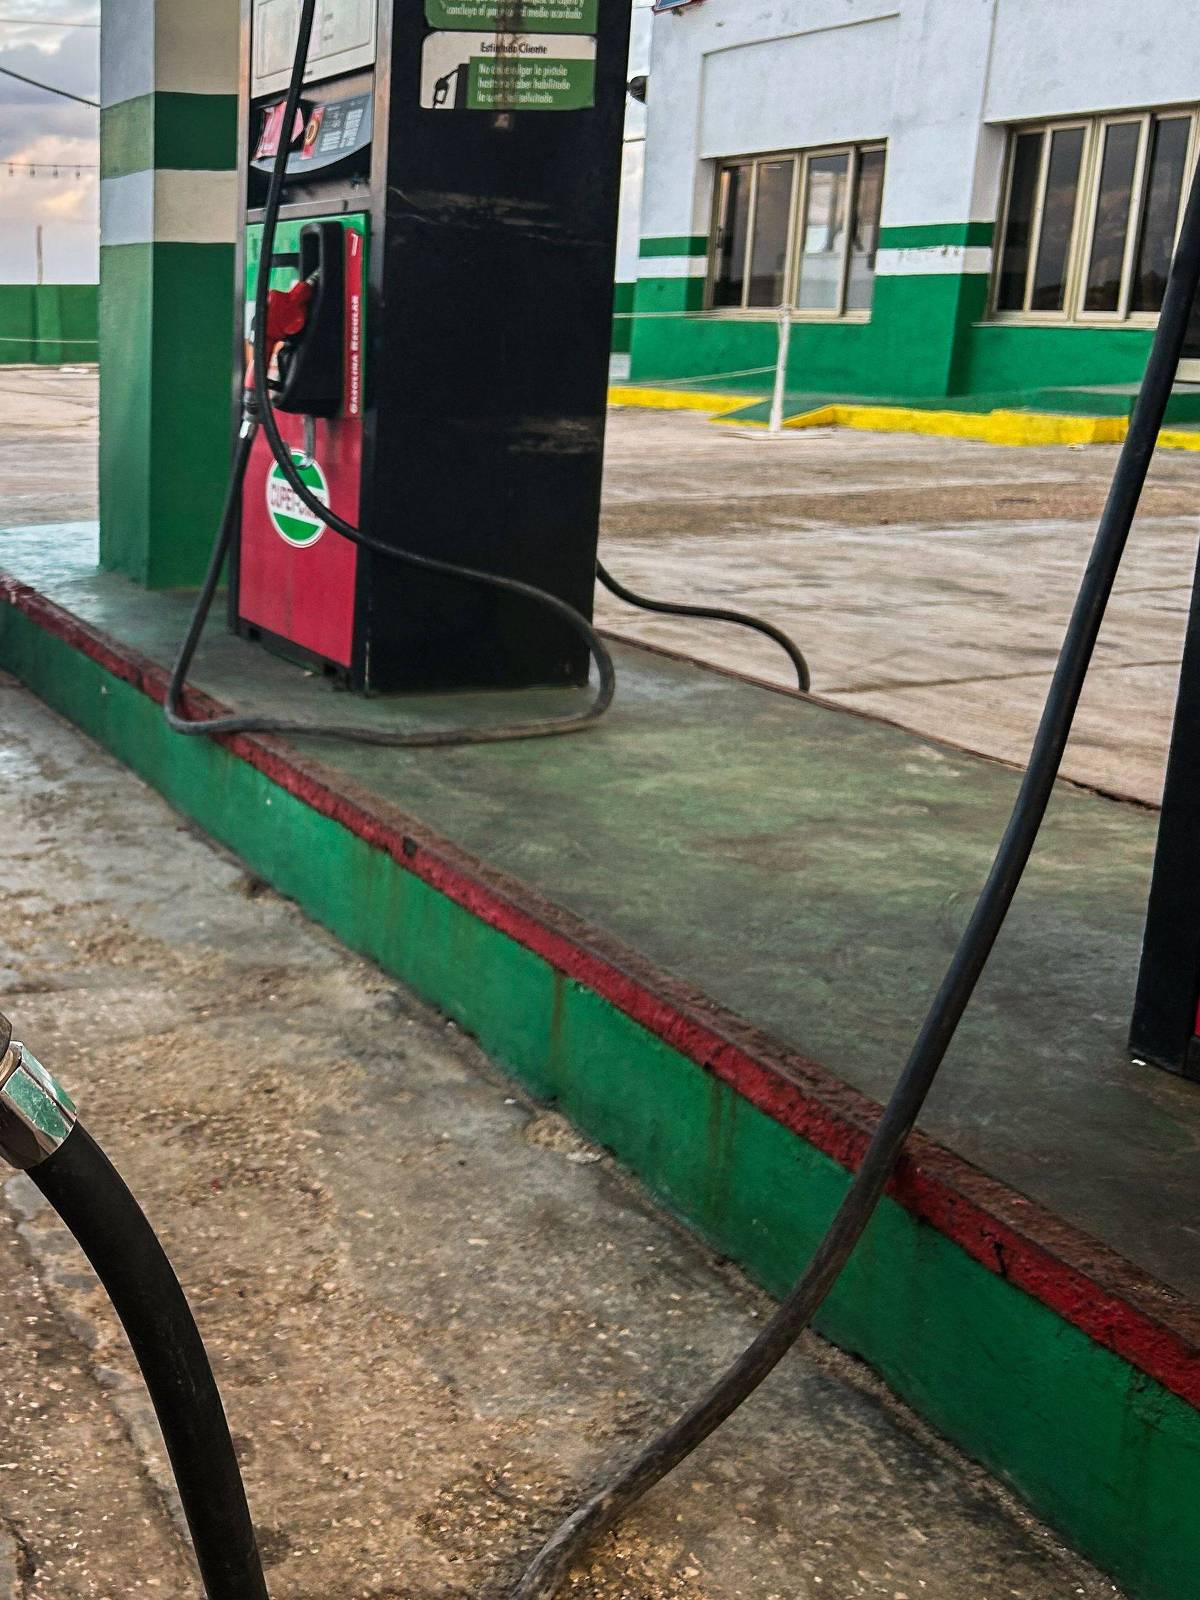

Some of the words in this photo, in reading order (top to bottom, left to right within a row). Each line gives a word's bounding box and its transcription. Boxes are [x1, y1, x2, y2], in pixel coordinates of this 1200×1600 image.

[519, 42, 547, 54] Cliente
[350, 295, 360, 352] REGULAR
[350, 354, 359, 415] GASOLINA
